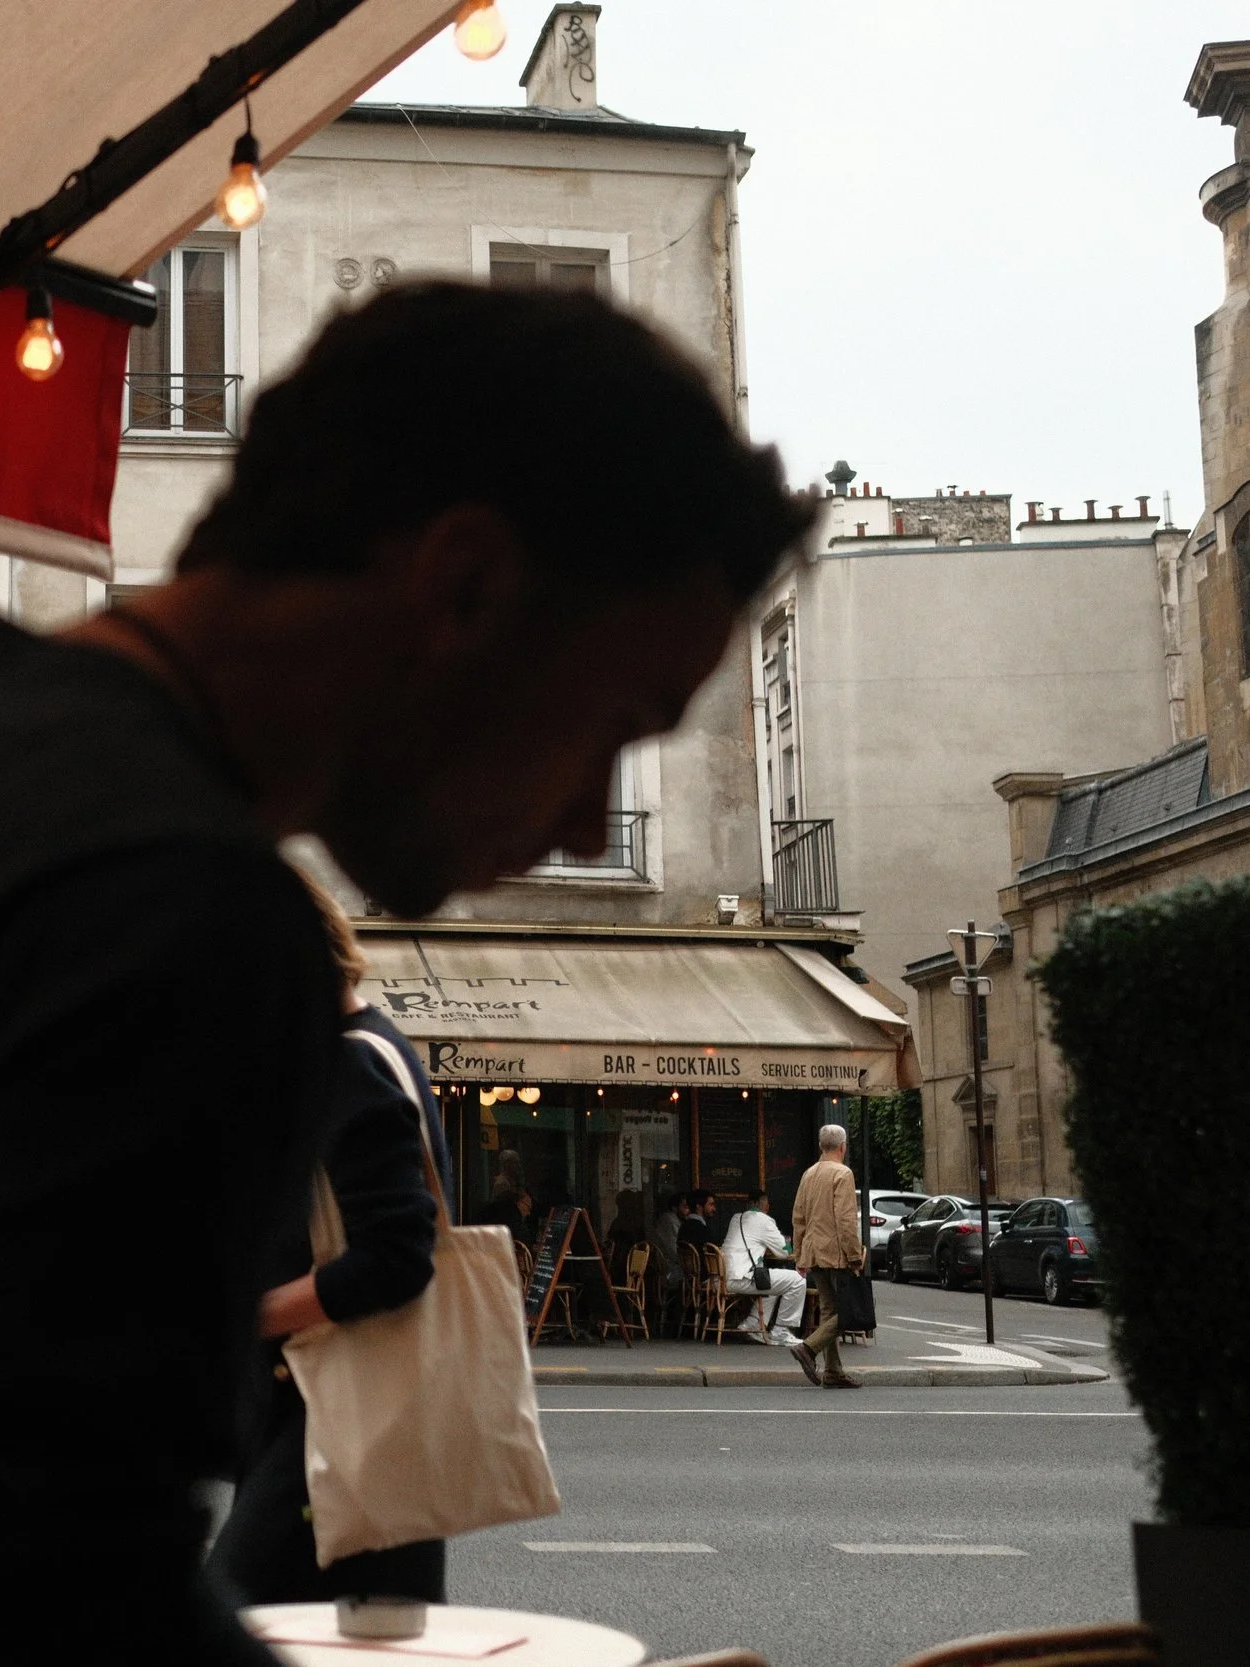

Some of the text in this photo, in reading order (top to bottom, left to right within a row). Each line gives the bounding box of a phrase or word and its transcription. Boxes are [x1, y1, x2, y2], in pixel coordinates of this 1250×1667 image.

[381, 991, 542, 1012] Rempart
[428, 1041, 526, 1074] Rempart
[604, 1055, 636, 1074] BAR
[656, 1056, 741, 1076] COCKTAILS
[761, 1063, 807, 1078] SERVICE
